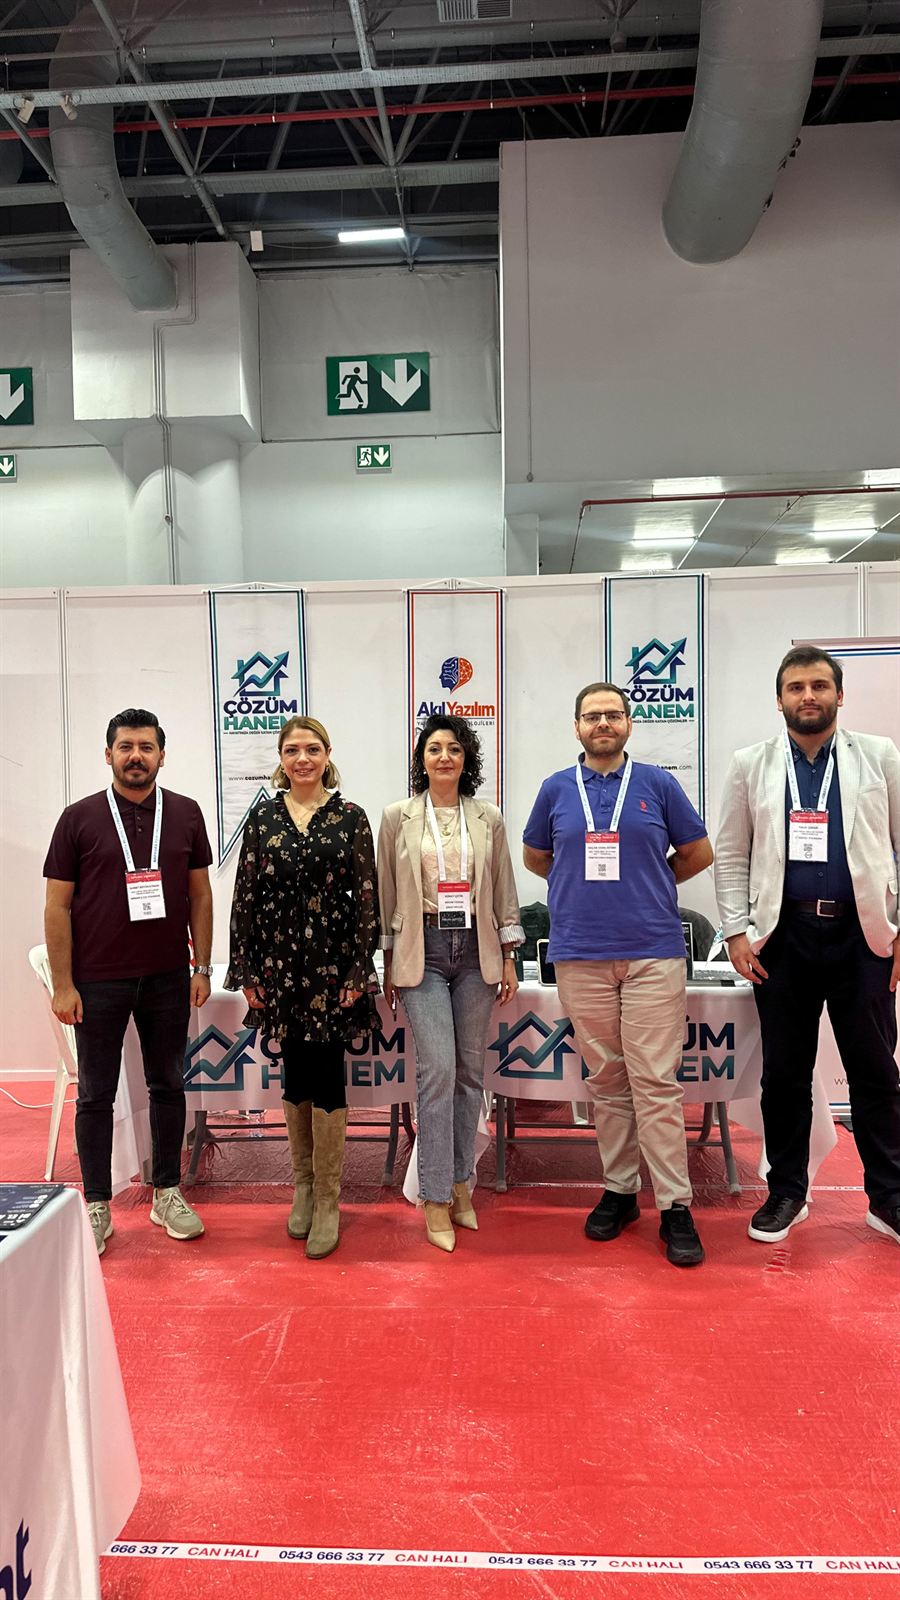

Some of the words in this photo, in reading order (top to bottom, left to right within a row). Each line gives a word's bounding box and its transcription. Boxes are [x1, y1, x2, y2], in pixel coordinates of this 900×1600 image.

[223, 696, 298, 718] ÇÖZÜM
[629, 704, 694, 719] ANEM
[110, 1544, 136, 1554] 666
[139, 1546, 158, 1555] 33
[161, 1546, 179, 1555] 77
[187, 1547, 221, 1557] CAN
[223, 1549, 260, 1559] HALI
[278, 1550, 313, 1560] 0543
[316, 1552, 343, 1561] 666
[346, 1553, 364, 1561] 33
[368, 1553, 385, 1562] 77
[395, 1554, 429, 1562] CAN
[432, 1555, 468, 1563] HALI
[488, 1556, 523, 1565] 0543
[527, 1558, 554, 1566] 666
[608, 1560, 643, 1568] CAN
[646, 1561, 684, 1569] HALI
[703, 1560, 740, 1569] 0543
[743, 1561, 772, 1570] 666
[774, 1561, 794, 1570] 33
[796, 1561, 814, 1570] 77
[825, 1560, 861, 1570] CAN
